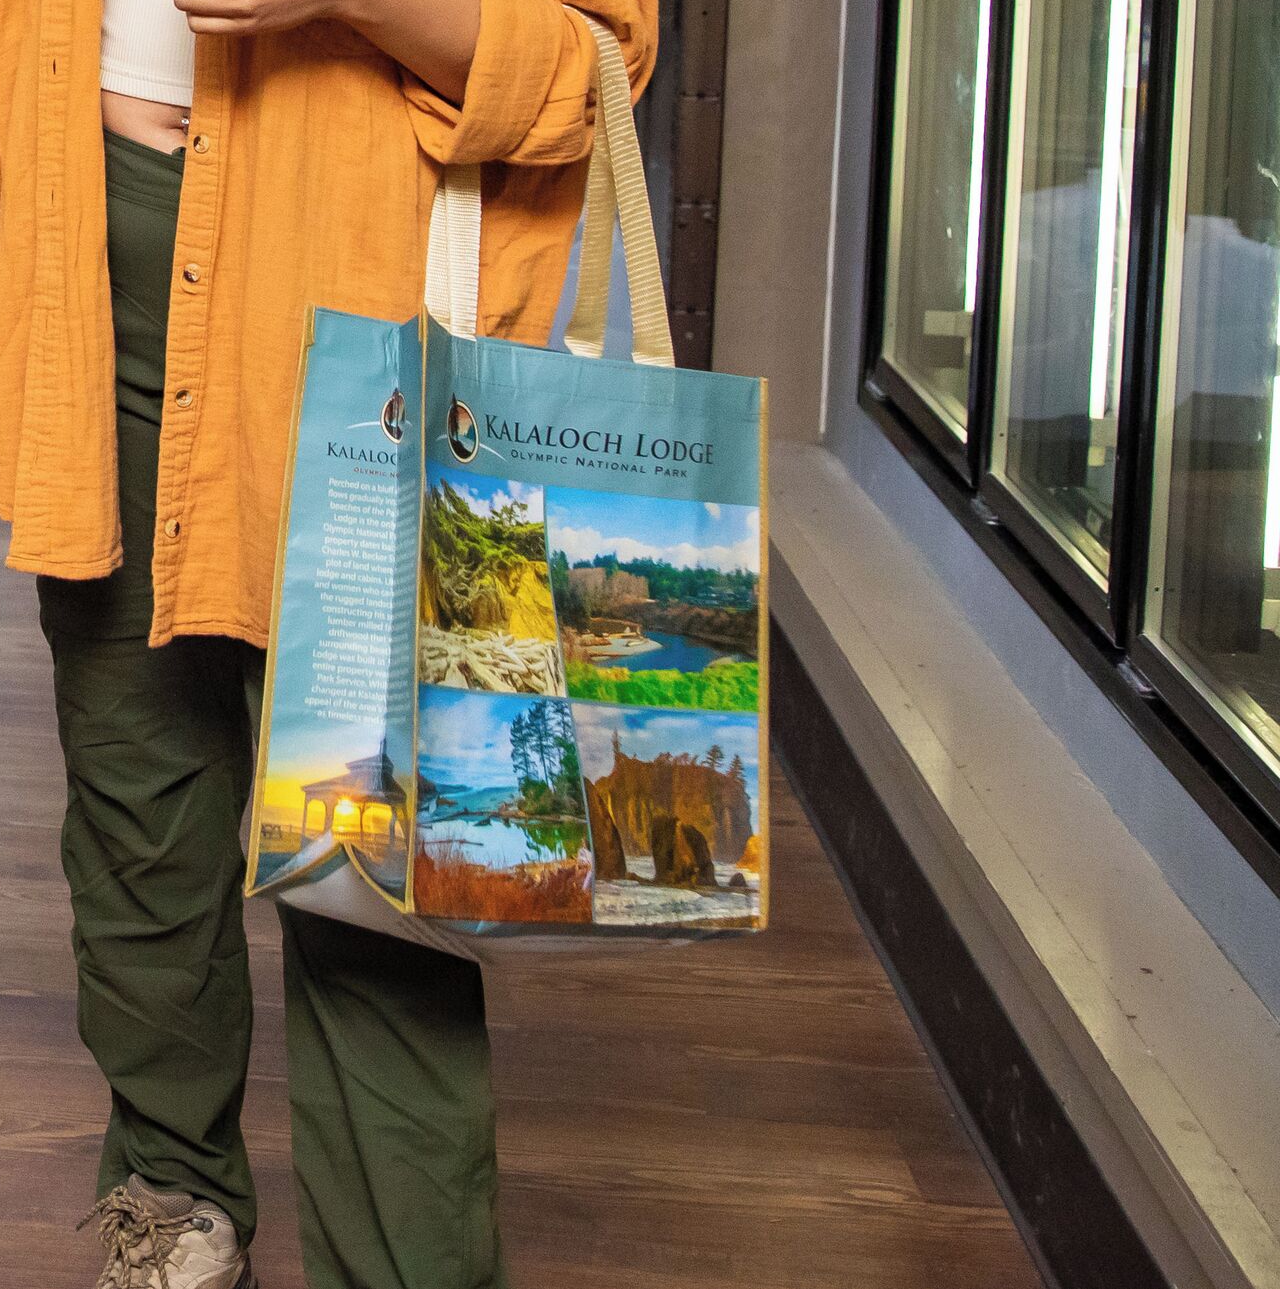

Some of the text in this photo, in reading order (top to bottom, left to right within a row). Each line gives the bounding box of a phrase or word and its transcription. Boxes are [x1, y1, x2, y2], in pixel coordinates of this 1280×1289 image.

[485, 413, 714, 465] KALALOCH LODGE
[510, 449, 689, 479] OLYMPIC NATIONAL PARK
[328, 477, 359, 489] Perched
[371, 506, 384, 515] the
[333, 513, 357, 525] Lodge
[366, 517, 379, 526] the
[323, 522, 387, 539] Olympic National
[324, 535, 358, 548] property
[321, 545, 350, 557] Charles
[352, 561, 369, 570] land
[316, 567, 339, 580] lodge
[341, 571, 356, 581] and
[314, 580, 329, 589] and
[320, 592, 333, 601] the
[312, 648, 337, 661] Lodge
[343, 700, 358, 710] the
